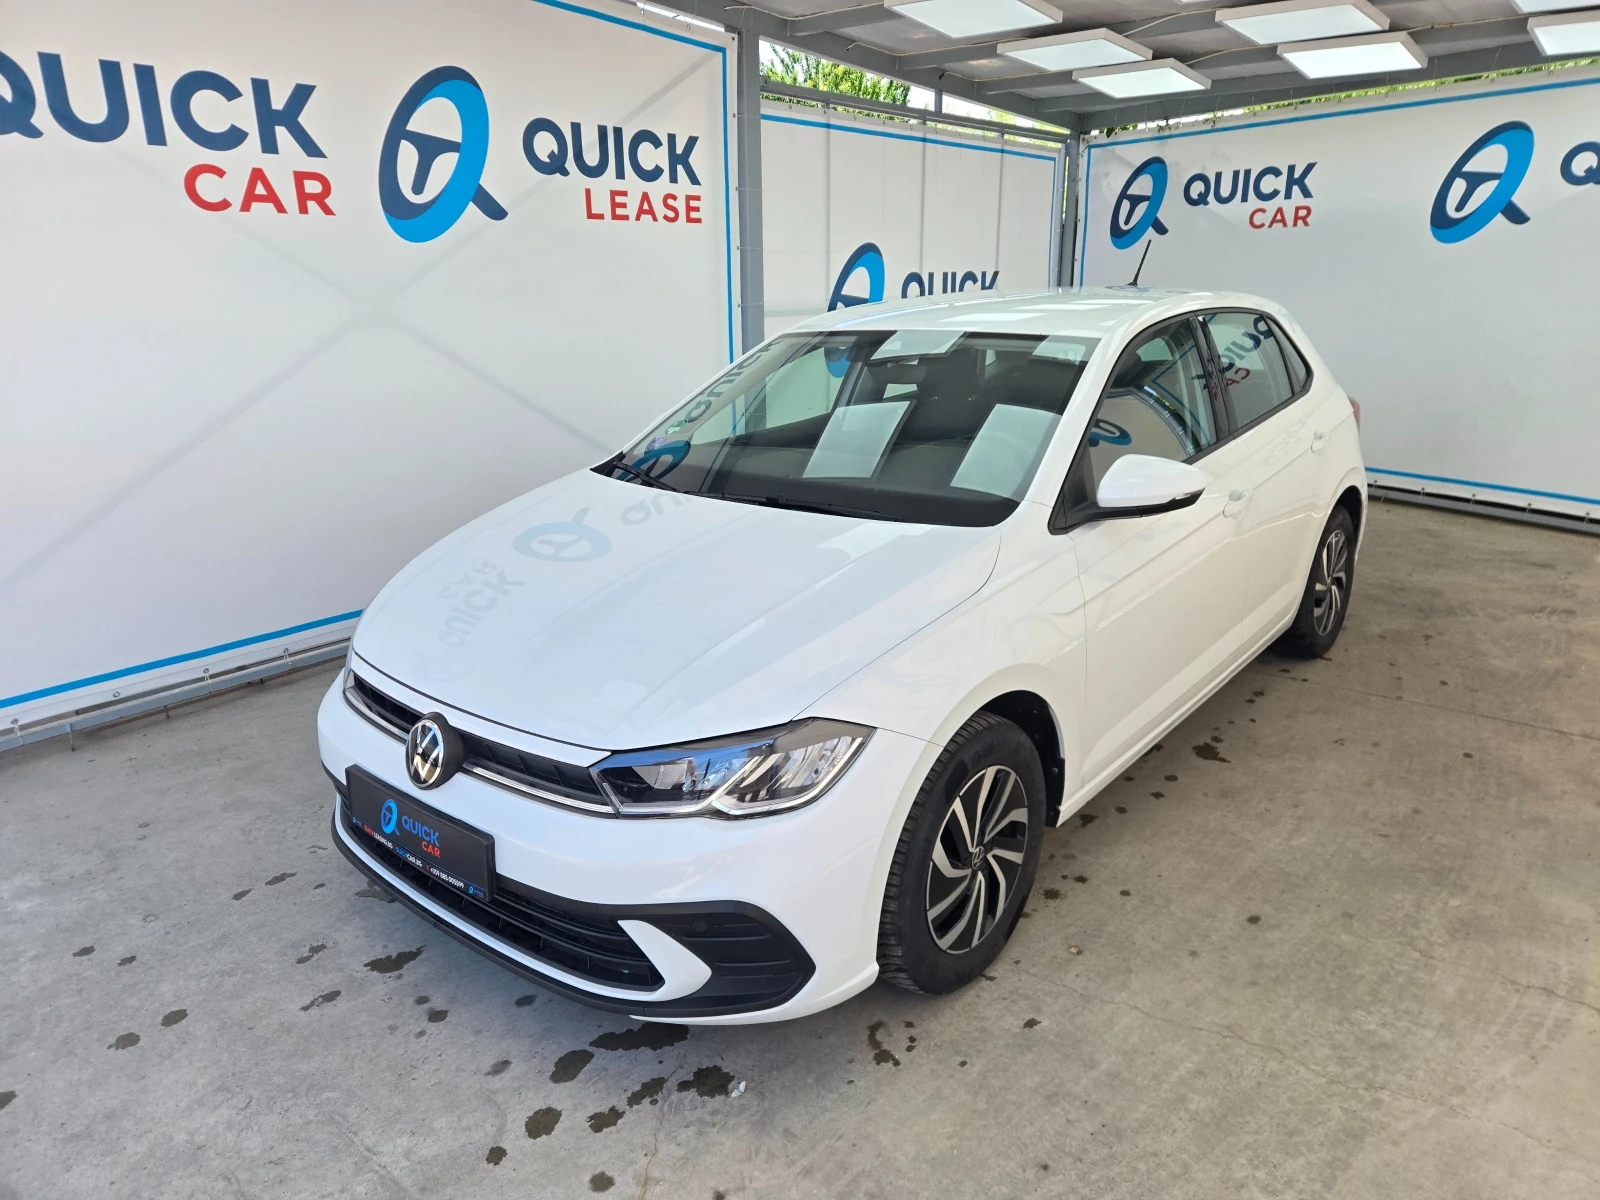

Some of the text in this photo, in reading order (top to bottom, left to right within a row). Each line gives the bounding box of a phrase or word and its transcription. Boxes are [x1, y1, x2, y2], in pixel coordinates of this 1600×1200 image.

[522, 117, 702, 186] QUICK
[183, 163, 336, 216] CAR
[1184, 162, 1318, 206] QUICK
[585, 188, 702, 224] LEASE
[1249, 205, 1312, 229] CAR
[401, 815, 440, 847] QUICK
[421, 841, 441, 858] CAR
